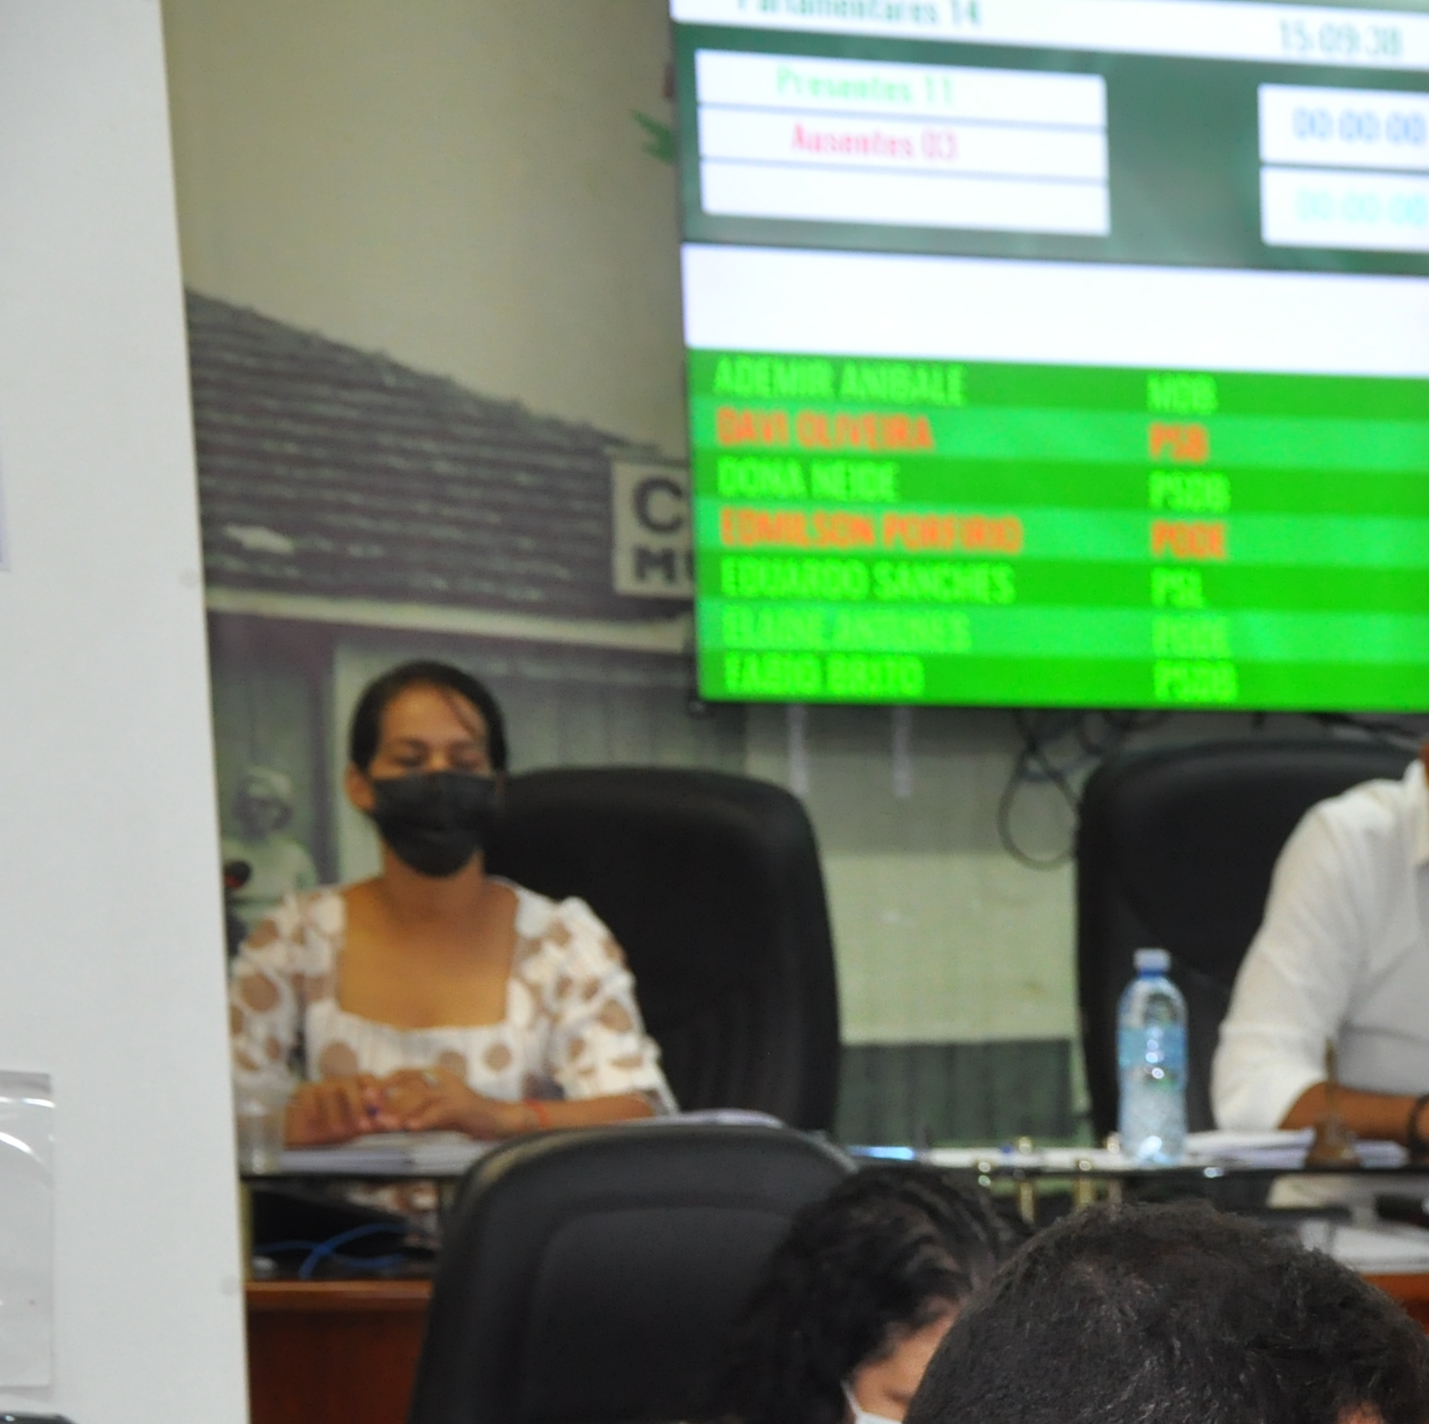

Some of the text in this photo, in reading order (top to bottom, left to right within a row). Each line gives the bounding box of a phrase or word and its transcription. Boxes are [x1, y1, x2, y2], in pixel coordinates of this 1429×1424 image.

[776, 64, 955, 104] Presentes 11
[791, 124, 914, 159] Ausentes
